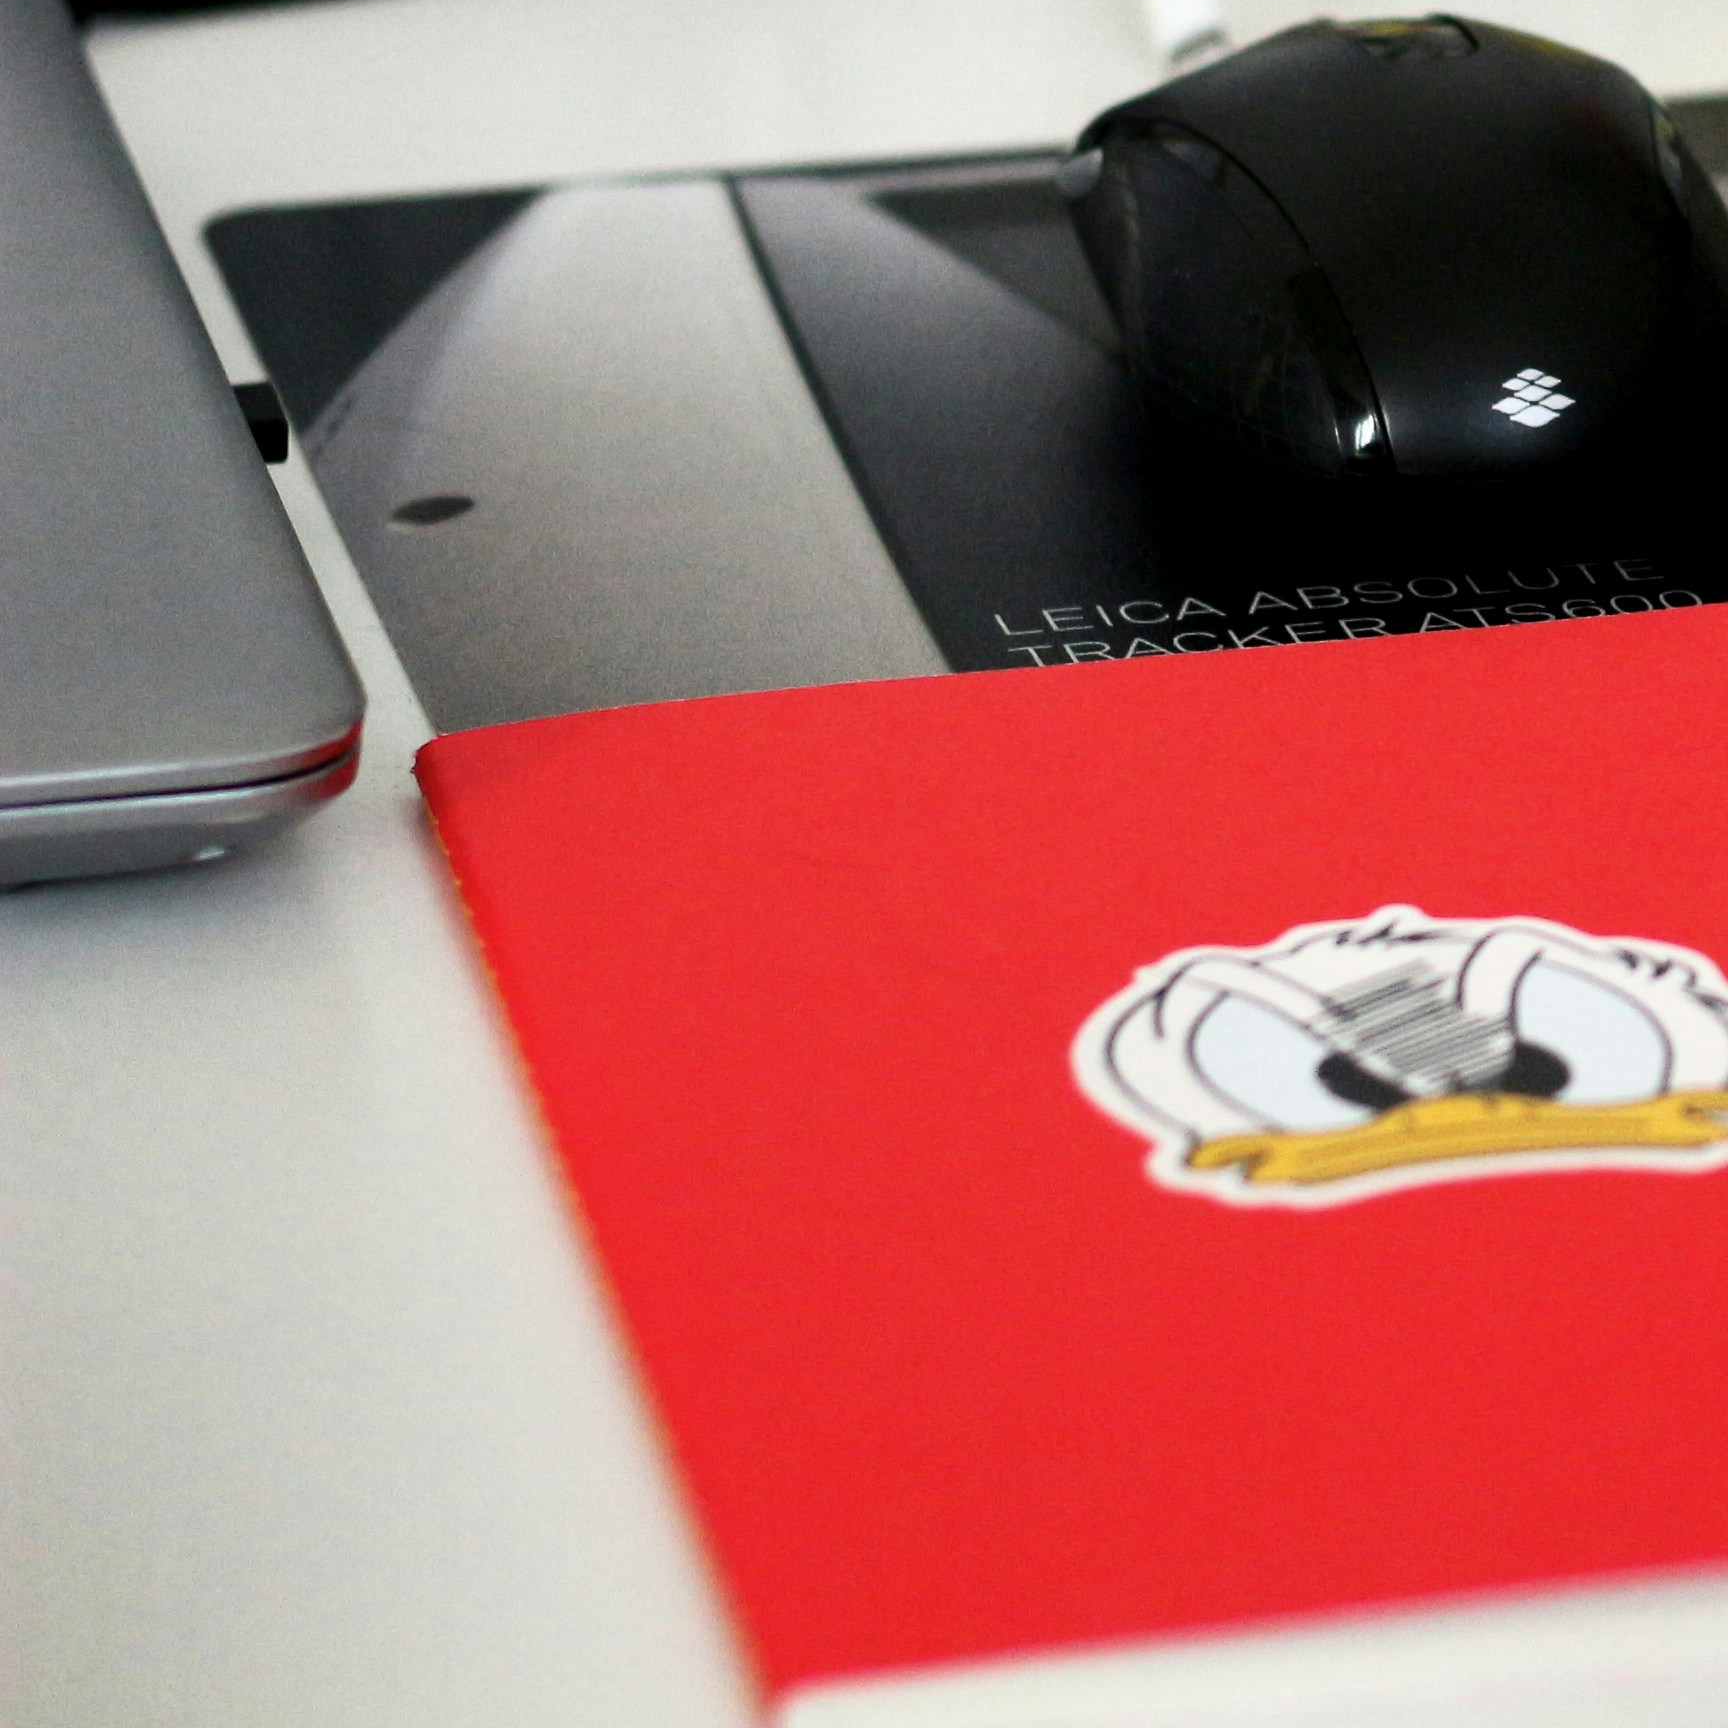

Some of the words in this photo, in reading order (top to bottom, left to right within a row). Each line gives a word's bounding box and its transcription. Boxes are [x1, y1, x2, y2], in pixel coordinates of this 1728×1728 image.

[993, 596, 1227, 637] LEICA
[1247, 557, 1665, 616] ABSOLUTE
[1006, 616, 1397, 668] TRACKER
[1418, 589, 1704, 635] ATS600
